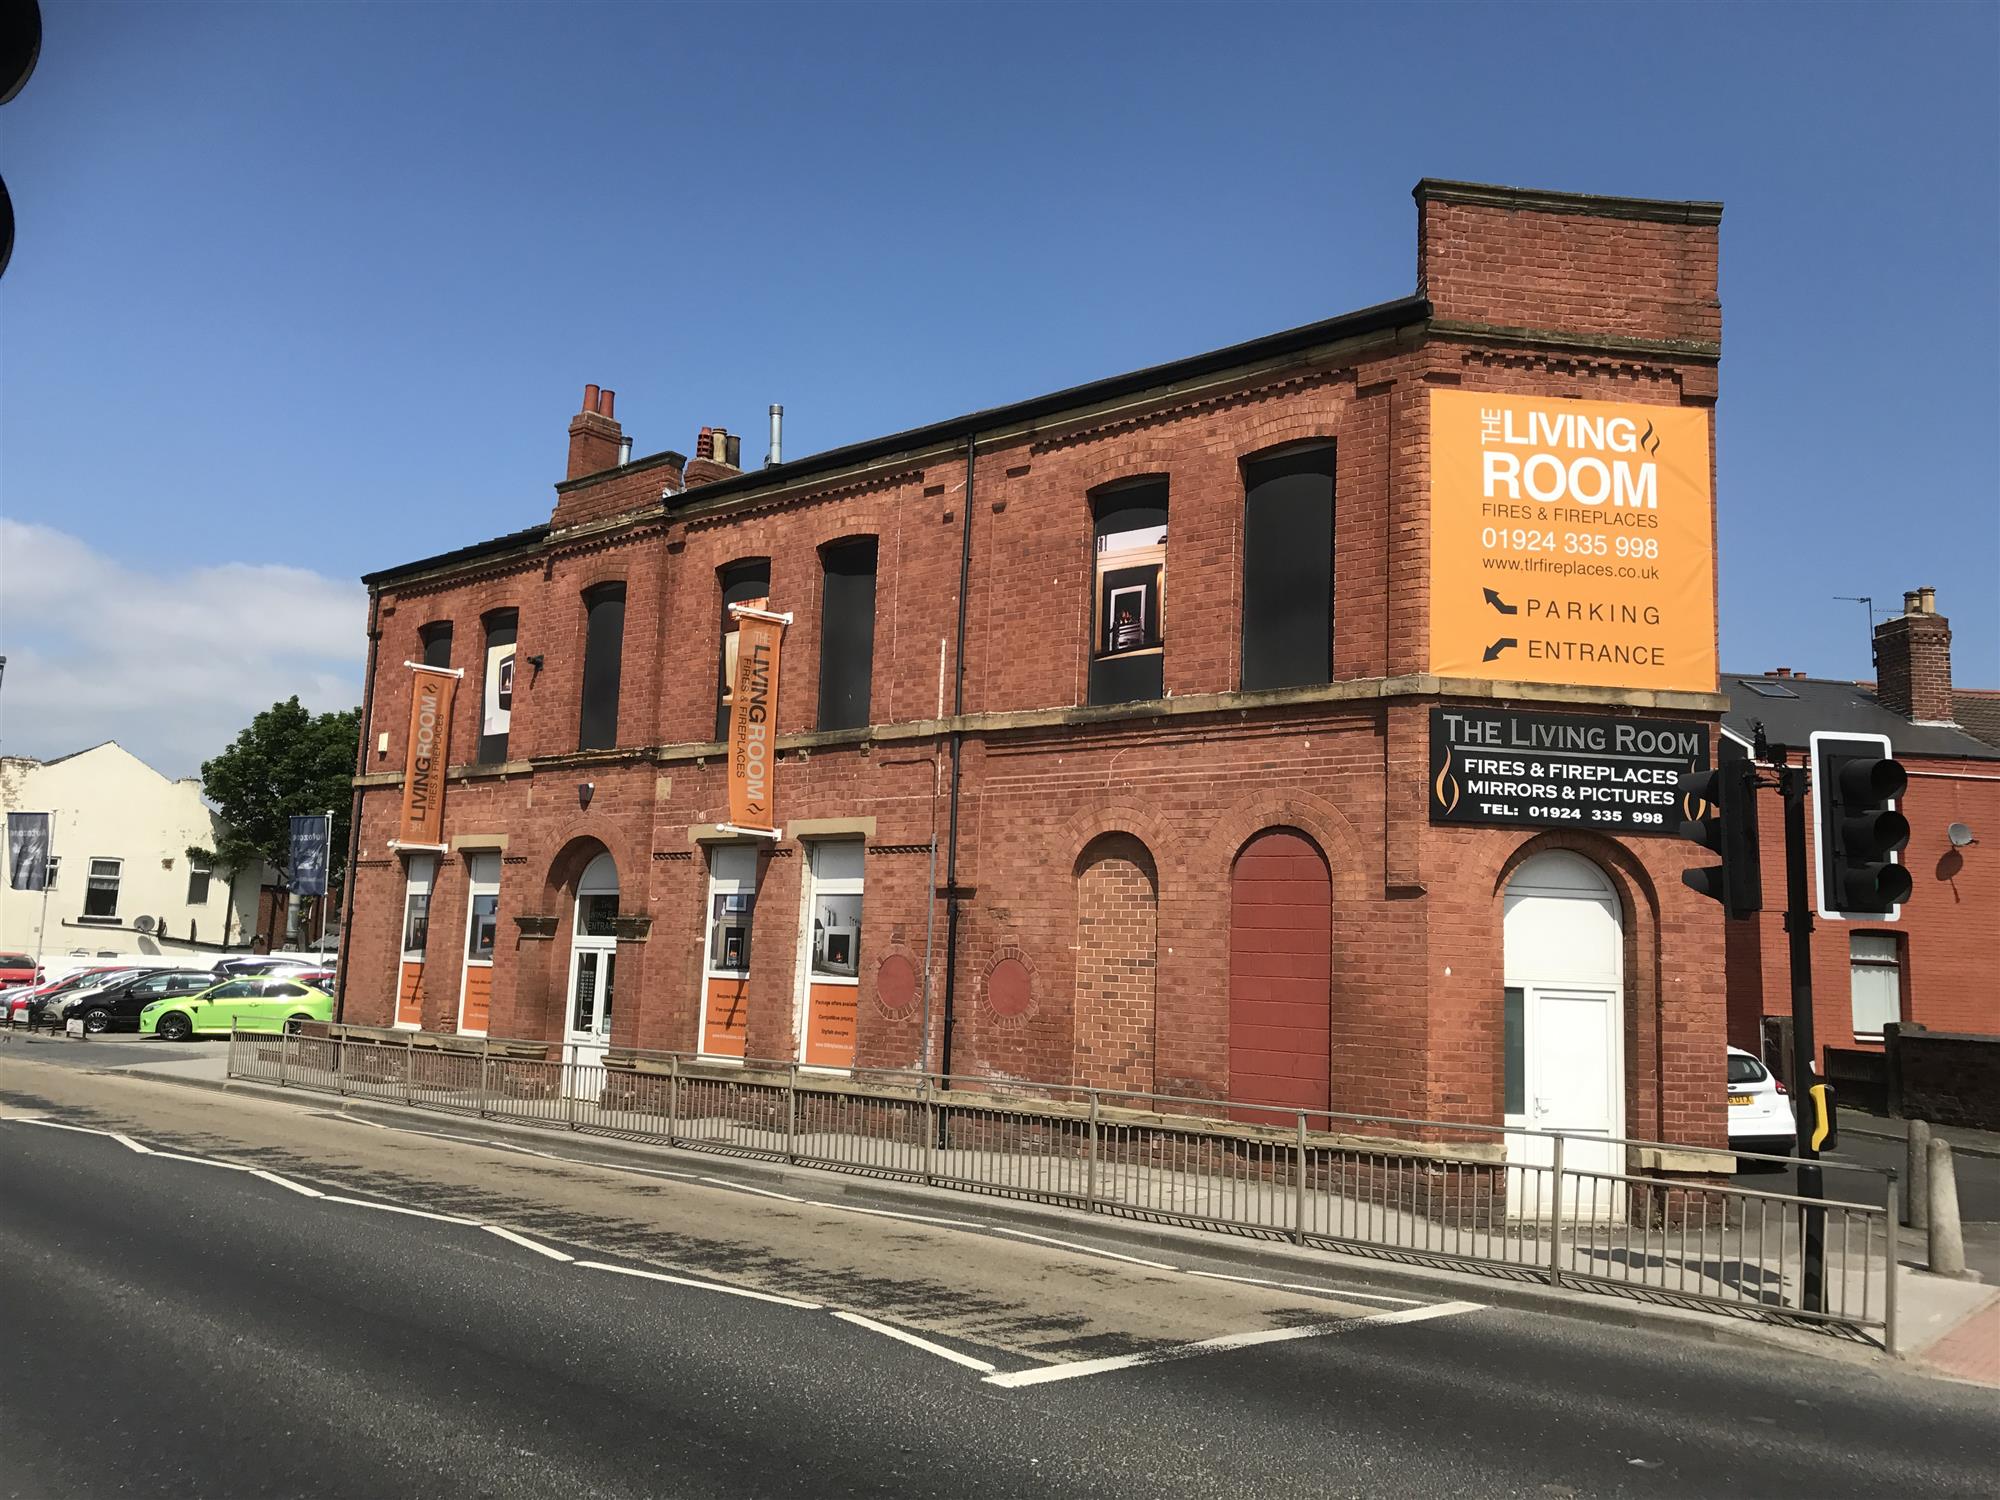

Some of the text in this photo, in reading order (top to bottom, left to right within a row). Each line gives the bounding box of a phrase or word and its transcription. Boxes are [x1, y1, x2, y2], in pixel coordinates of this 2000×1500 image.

[1481, 408, 1636, 452] THE LIVING
[1483, 450, 1658, 508] ROOM
[1482, 504, 1658, 528] FIRES & FIREPLACES
[1482, 528, 1658, 560] 01924 335 998
[1483, 557, 1659, 580] www.tlrfireplaces.co.uk
[1528, 599, 1660, 624] PARKING
[1529, 640, 1664, 666] ENTRANCE
[740, 658, 752, 692] FIRES
[432, 714, 444, 772] FIREPLACES
[736, 706, 748, 778] FIREPLACES
[1464, 758, 1678, 784] FIRES & FIREPLACES
[428, 782, 438, 810] FIRES
[1468, 780, 1674, 805] MIRRORS & PICTURES
[1480, 803, 1663, 824] TEL: 01924 335 998
